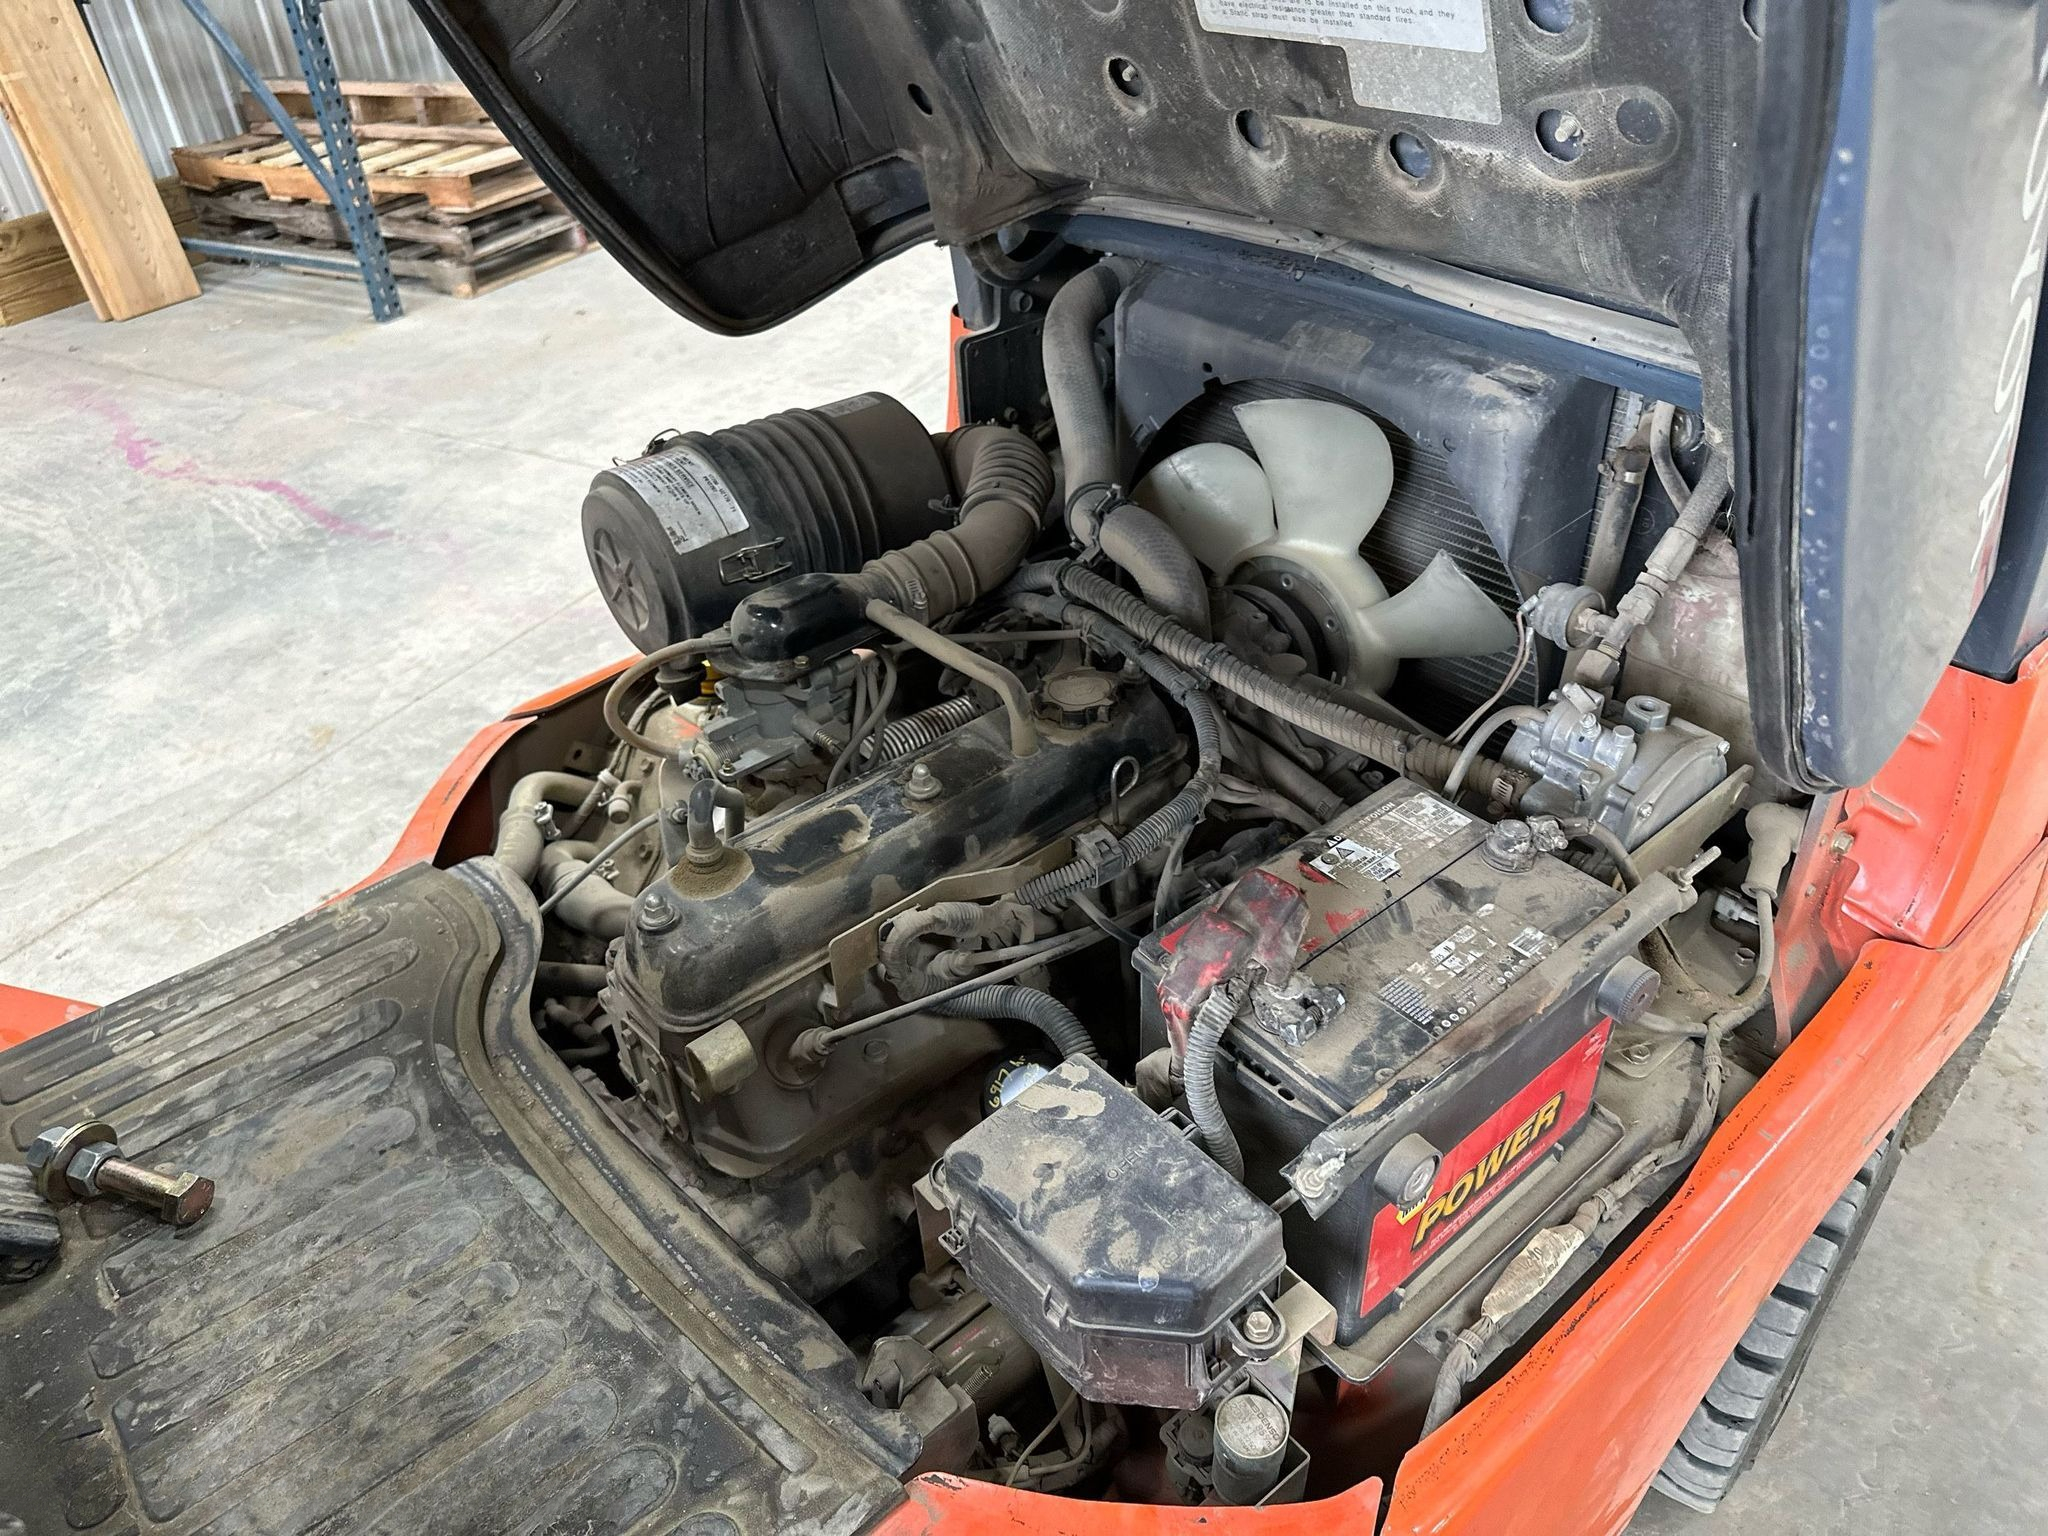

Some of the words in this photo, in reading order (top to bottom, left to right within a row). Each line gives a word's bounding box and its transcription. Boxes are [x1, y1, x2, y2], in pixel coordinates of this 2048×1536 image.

[1238, 1, 1267, 10] electrical
[1310, 8, 1334, 17] greater
[1339, 10, 1355, 18] than
[1359, 12, 1391, 22] standard
[1251, 11, 1268, 20] strap
[1292, 15, 1306, 23] also
[1328, 0, 1358, 10] installed
[1376, 4, 1391, 13] this
[1419, 9, 1433, 17] and
[1438, 9, 1455, 20] they
[989, 1068, 1013, 1108] 6917
[1410, 1091, 1565, 1253] POWER
[1256, 1411, 1281, 1442] DENSO
